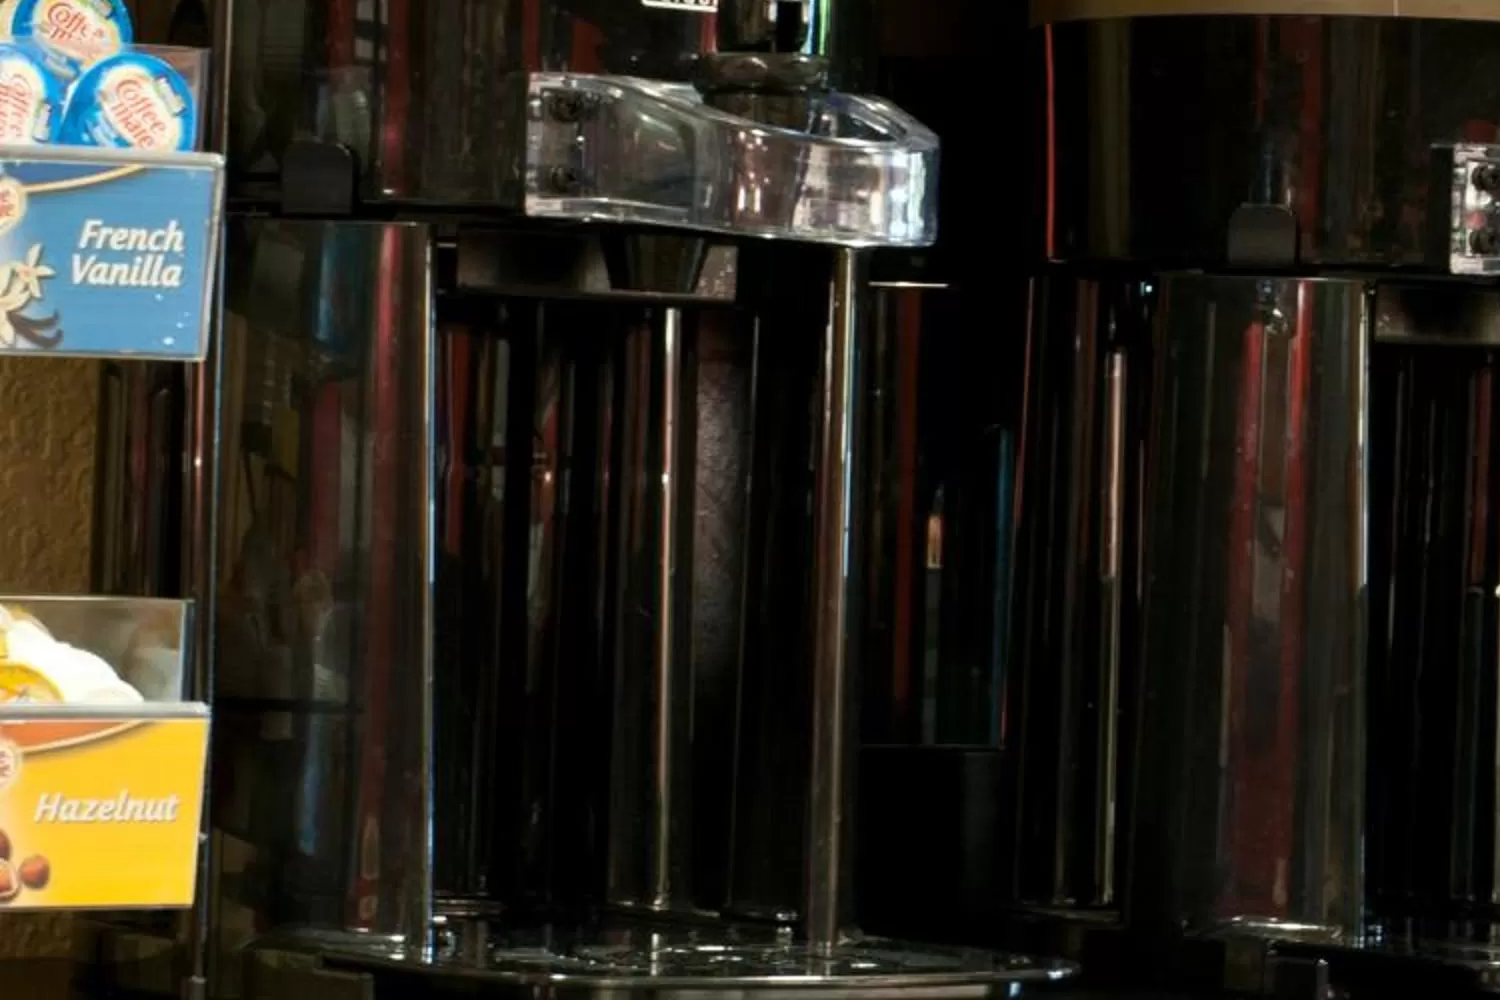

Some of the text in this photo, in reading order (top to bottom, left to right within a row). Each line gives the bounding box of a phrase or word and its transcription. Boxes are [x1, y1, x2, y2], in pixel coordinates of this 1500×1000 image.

[78, 219, 185, 252] French
[72, 253, 183, 288] Vanilla
[34, 789, 181, 824] Hazelnut
